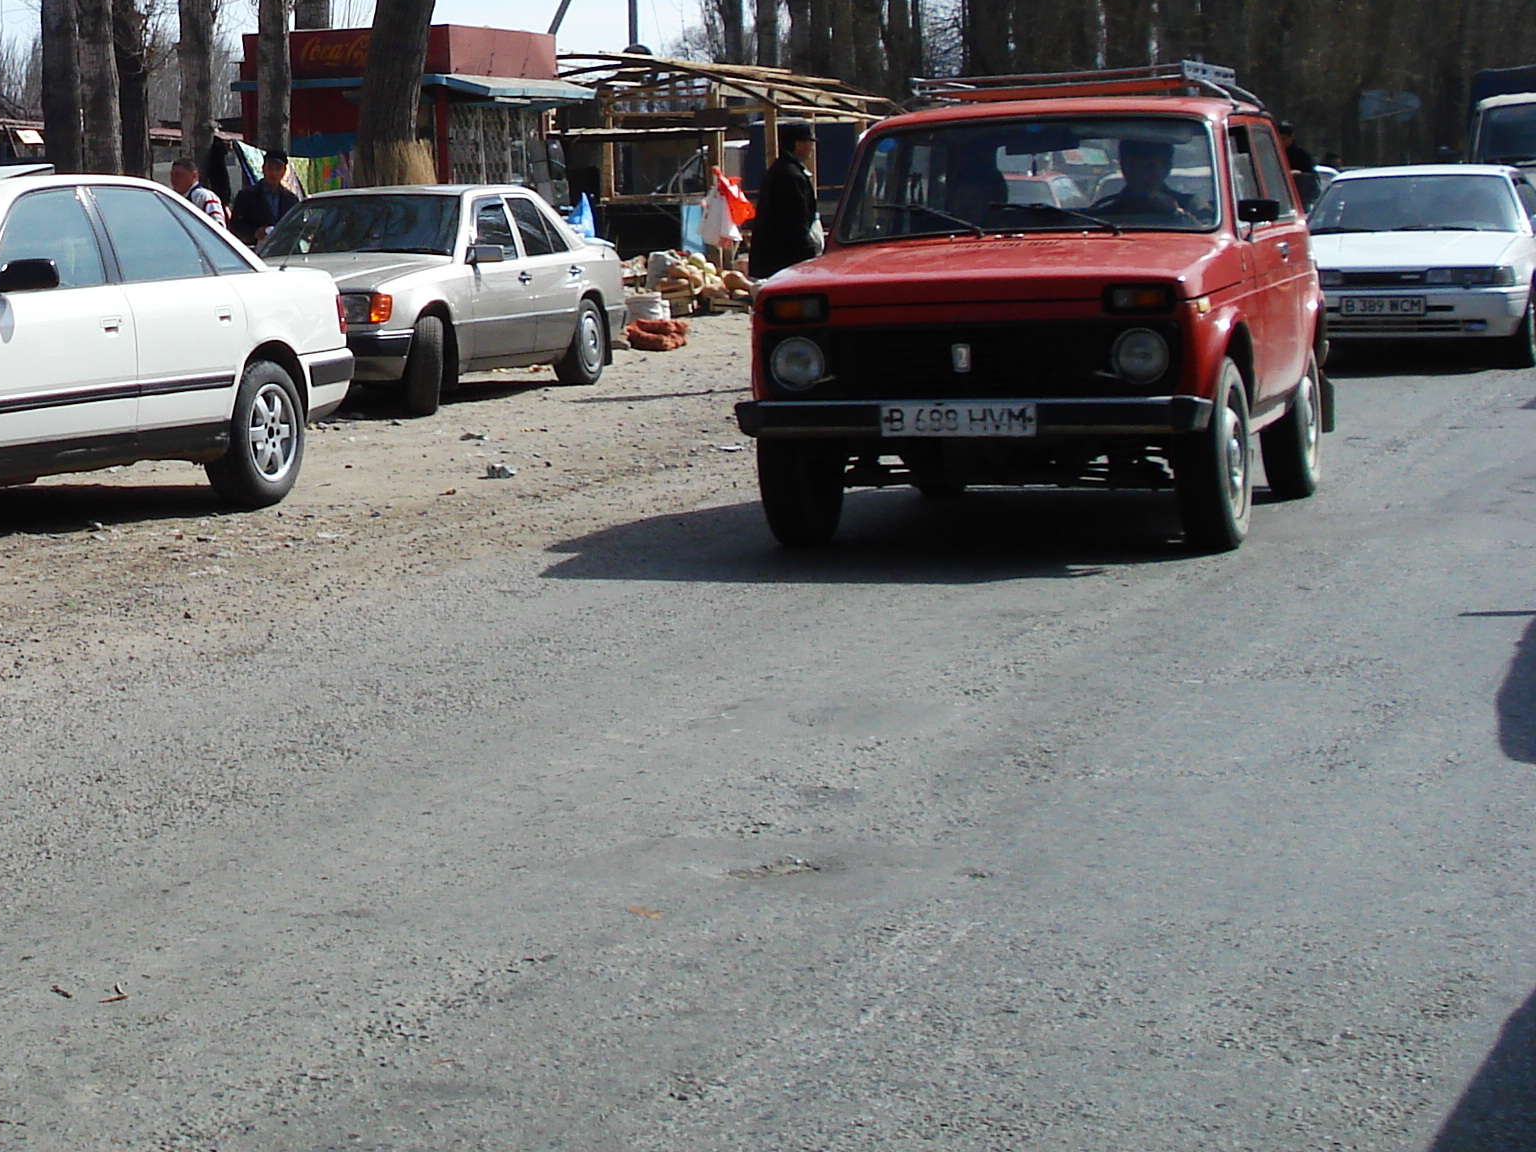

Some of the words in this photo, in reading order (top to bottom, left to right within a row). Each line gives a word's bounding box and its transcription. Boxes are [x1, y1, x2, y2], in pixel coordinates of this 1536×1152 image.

[1345, 299, 1355, 312] B
[889, 408, 904, 432] B
[968, 408, 1028, 432] HVM
